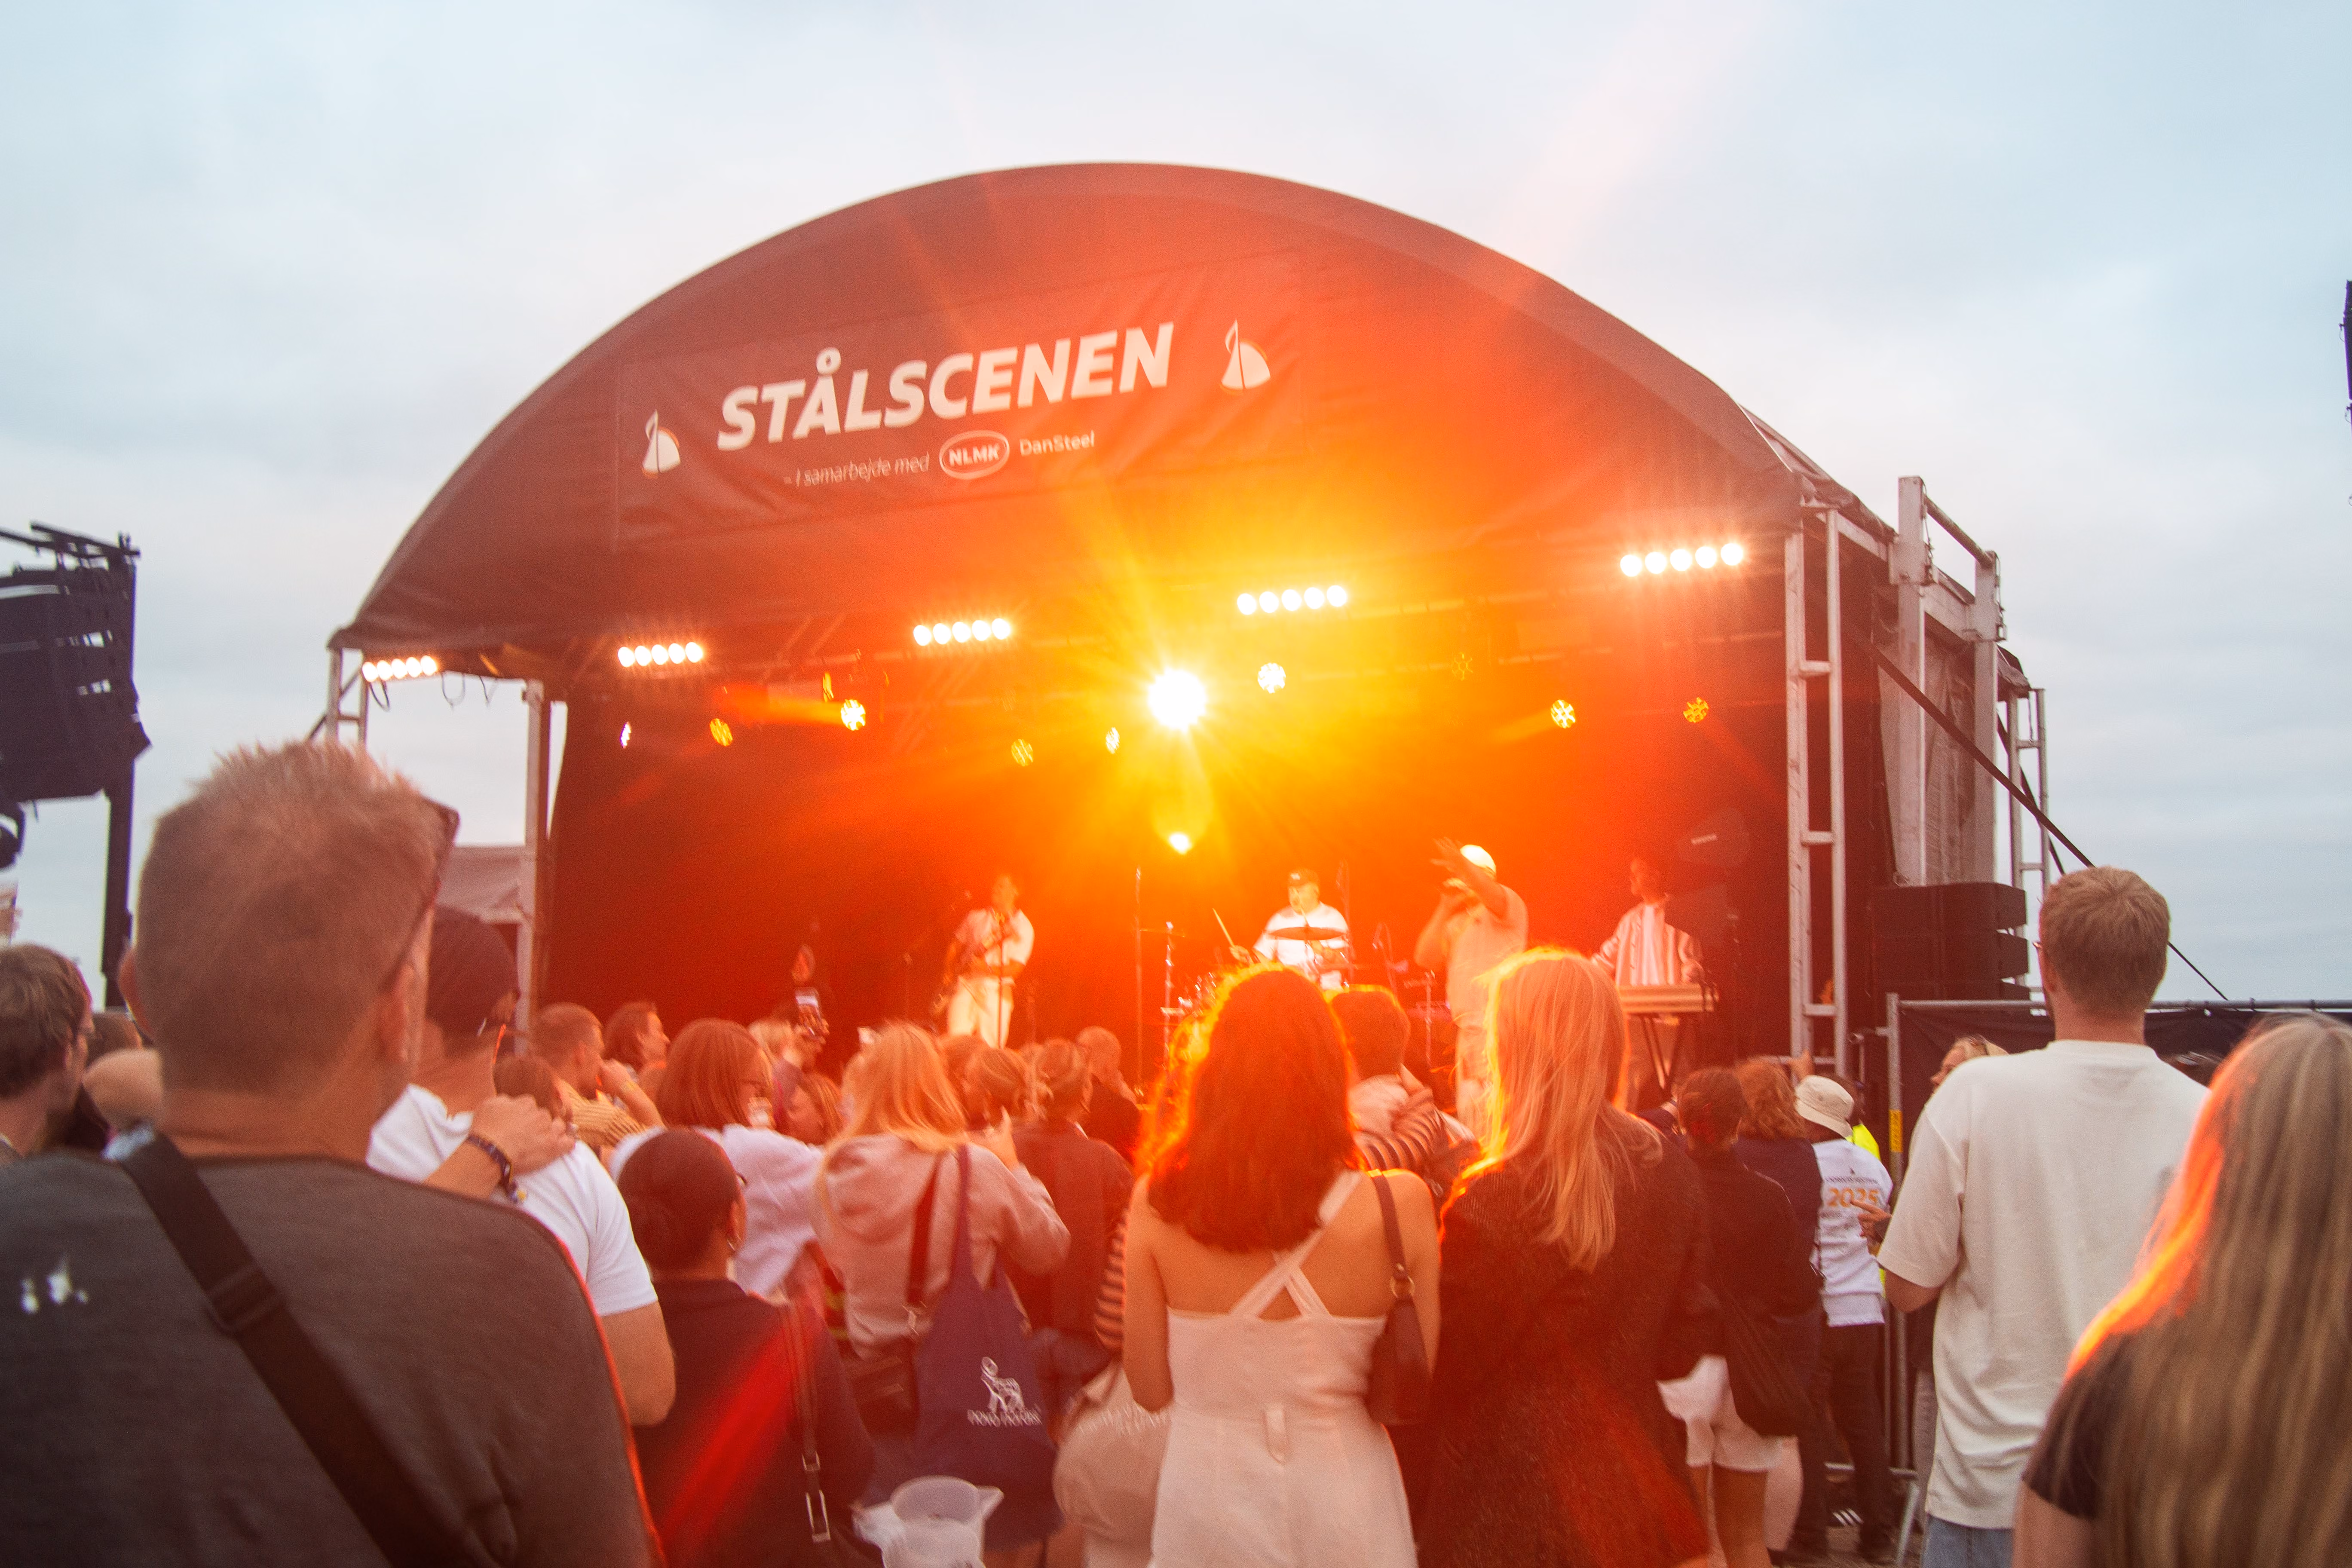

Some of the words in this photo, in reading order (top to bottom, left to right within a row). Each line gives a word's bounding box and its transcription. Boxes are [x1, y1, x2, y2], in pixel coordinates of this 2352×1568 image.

[717, 322, 1174, 451] STÅLSCENEN
[804, 457, 891, 487] samarbejde
[894, 451, 930, 474] med
[948, 443, 1000, 466] NLMK
[1019, 429, 1094, 456] DanSteel
[1828, 1187, 1879, 1208] 2025
